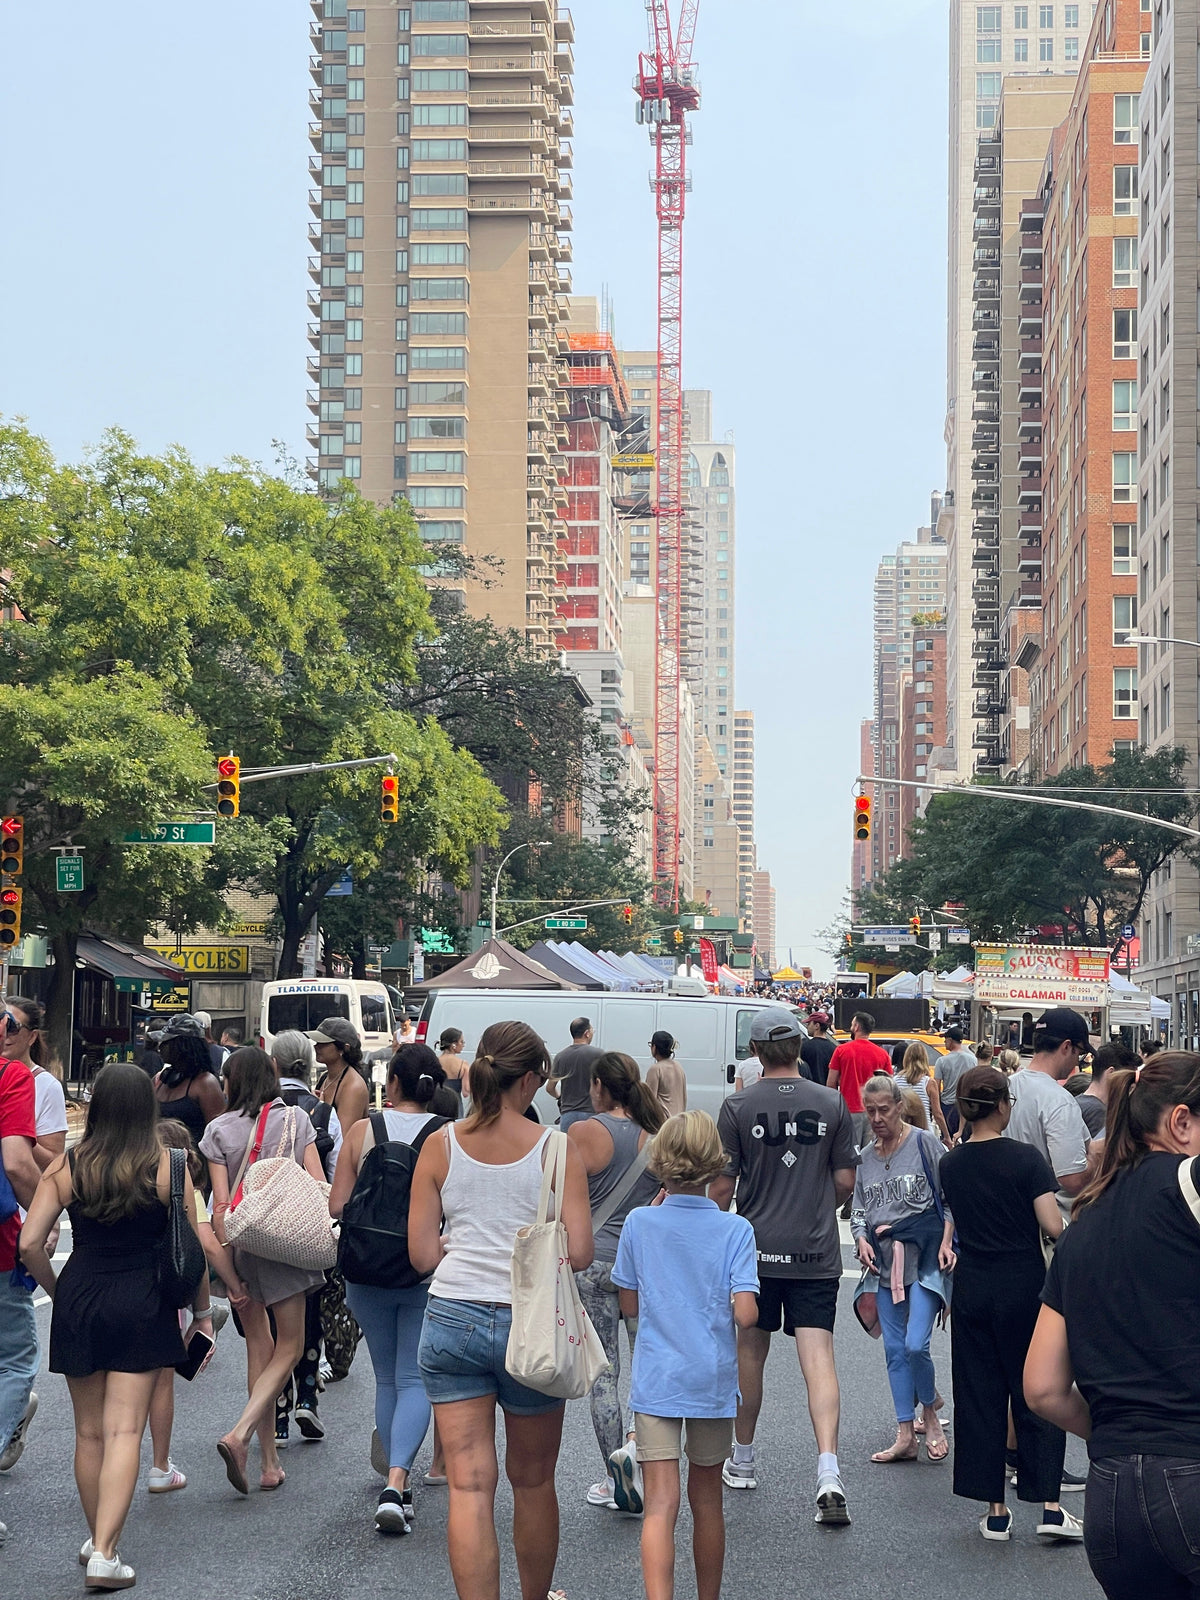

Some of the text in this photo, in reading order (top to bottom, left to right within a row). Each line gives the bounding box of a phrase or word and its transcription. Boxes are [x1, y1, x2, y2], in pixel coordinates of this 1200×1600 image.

[172, 827, 185, 839] St
[65, 873, 75, 881] 15
[1009, 956, 1074, 975] SAUSAGE
[277, 985, 340, 994] TLAXCALITA
[1009, 989, 1066, 1000] CALAMARI
